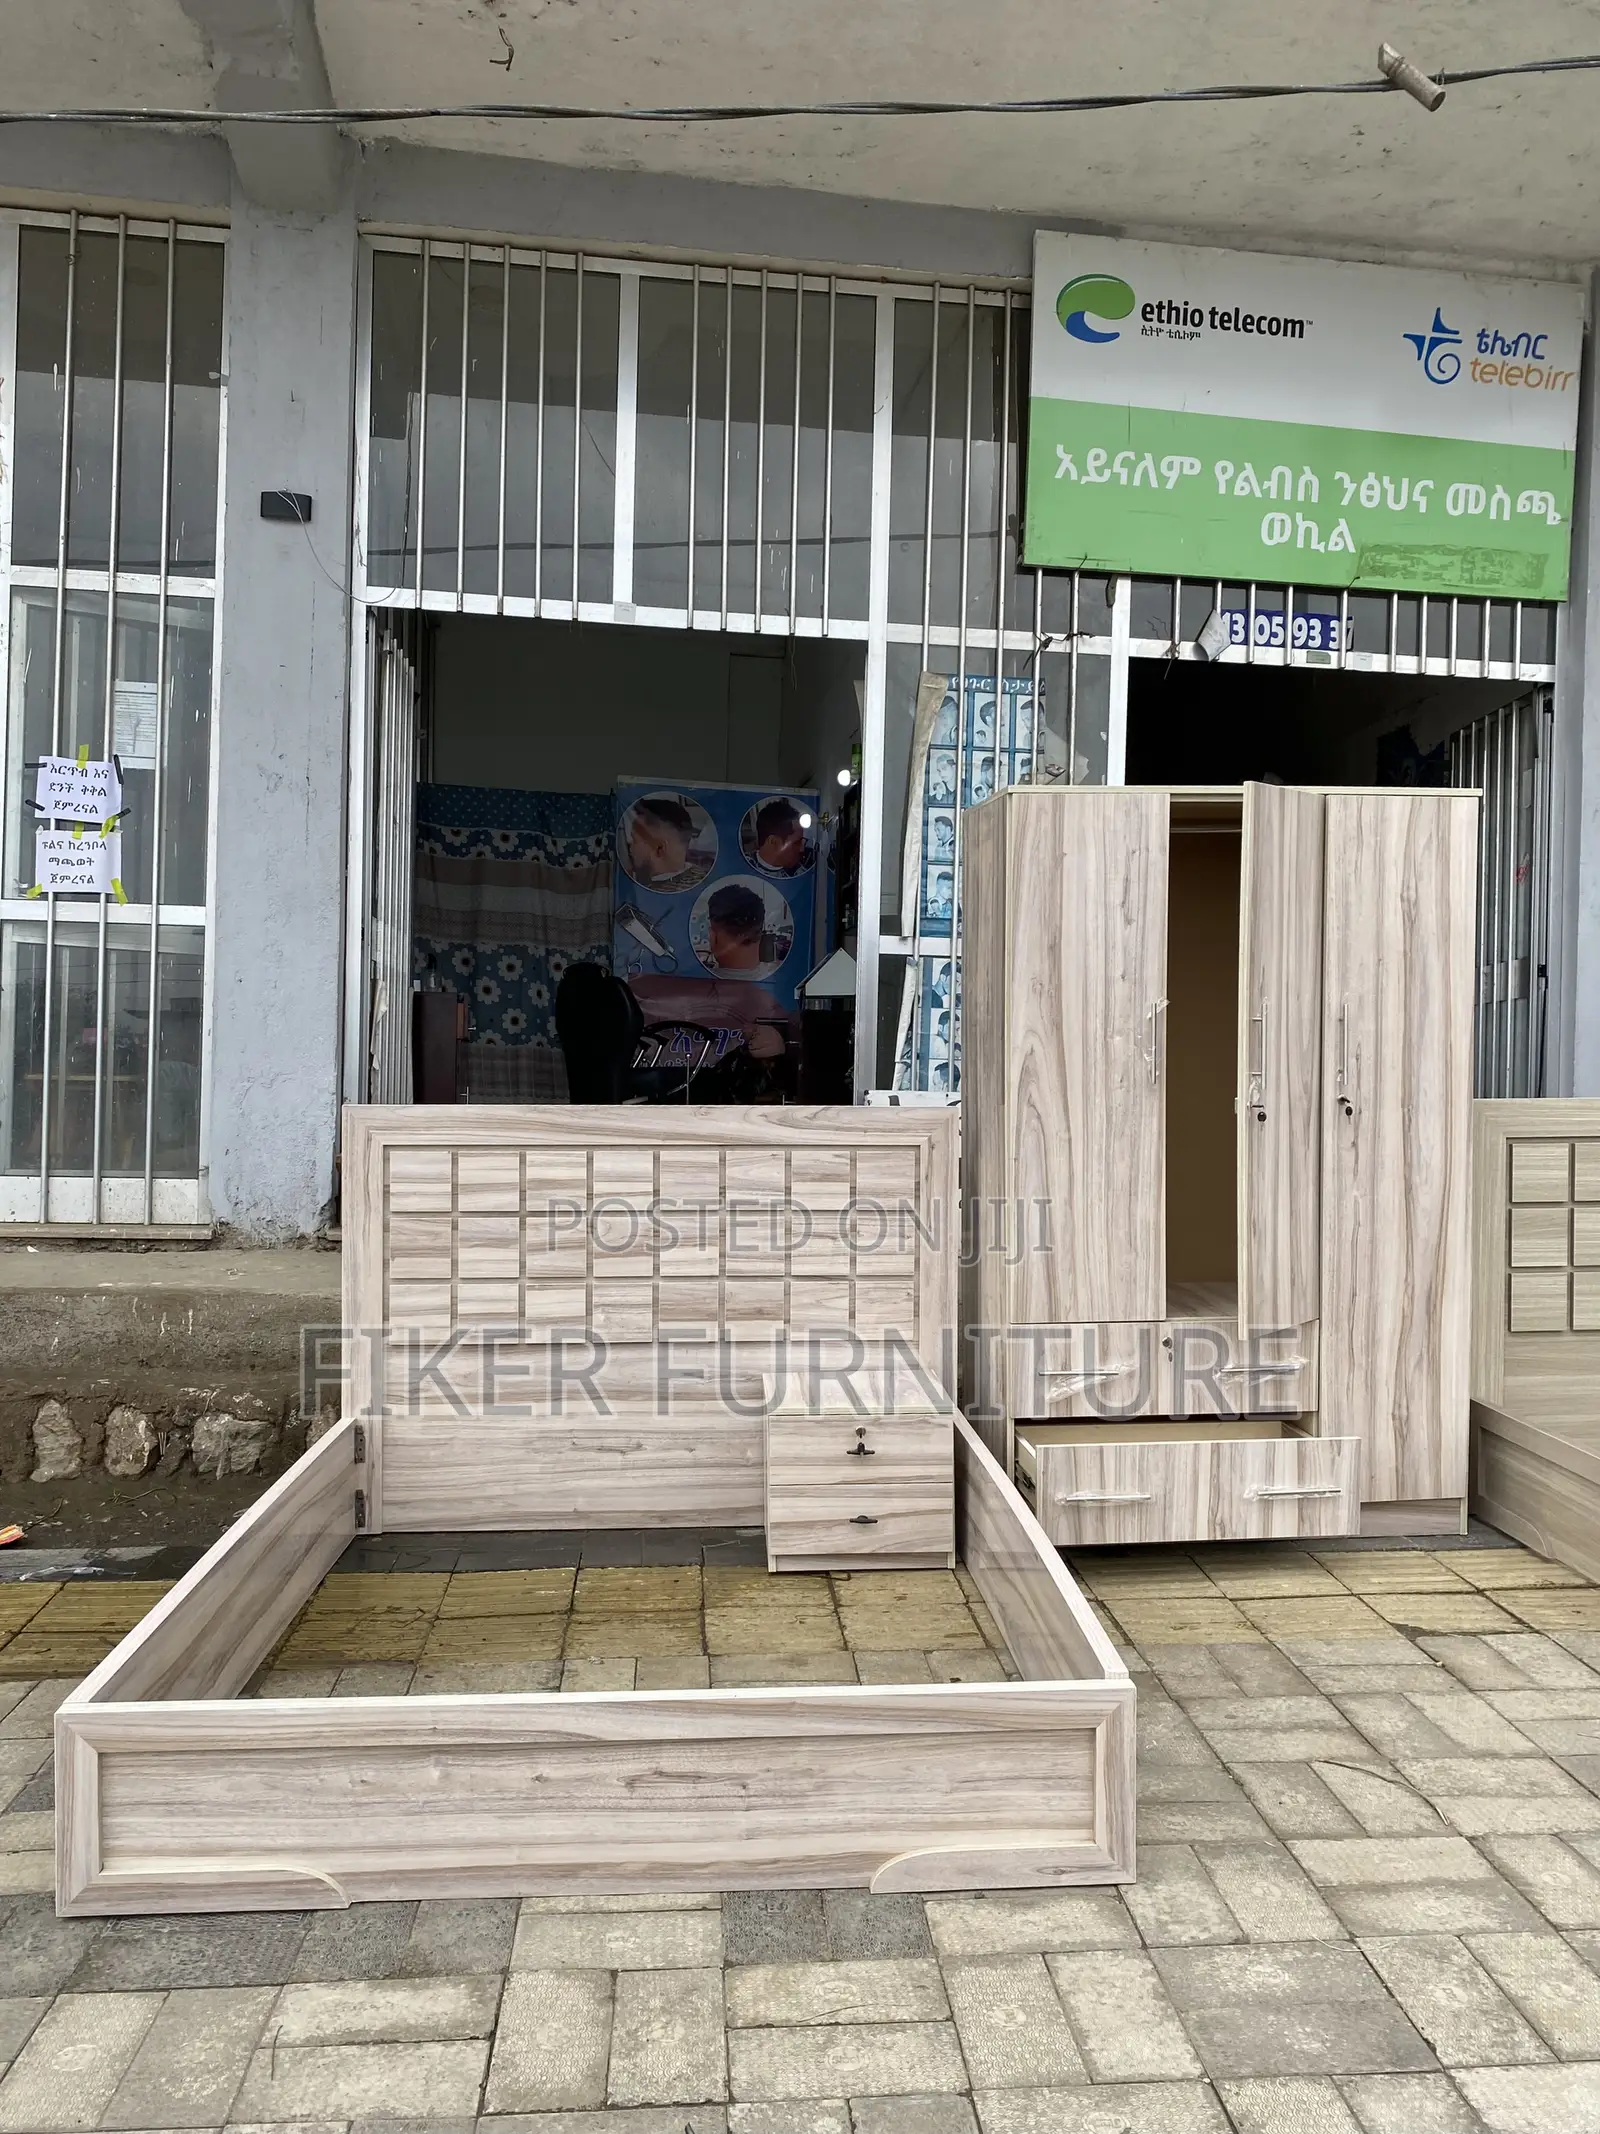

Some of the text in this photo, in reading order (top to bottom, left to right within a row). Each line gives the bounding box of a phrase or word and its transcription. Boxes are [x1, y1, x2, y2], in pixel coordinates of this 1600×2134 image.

[1141, 299, 1204, 328] ethio
[1470, 357, 1576, 391] telebirr
[1054, 443, 1202, 490] አይናለም
[1214, 460, 1320, 503] የልብስ
[1334, 471, 1435, 514] ንፅህና
[1260, 512, 1357, 554] ወኪል
[1292, 617, 1322, 649] 93
